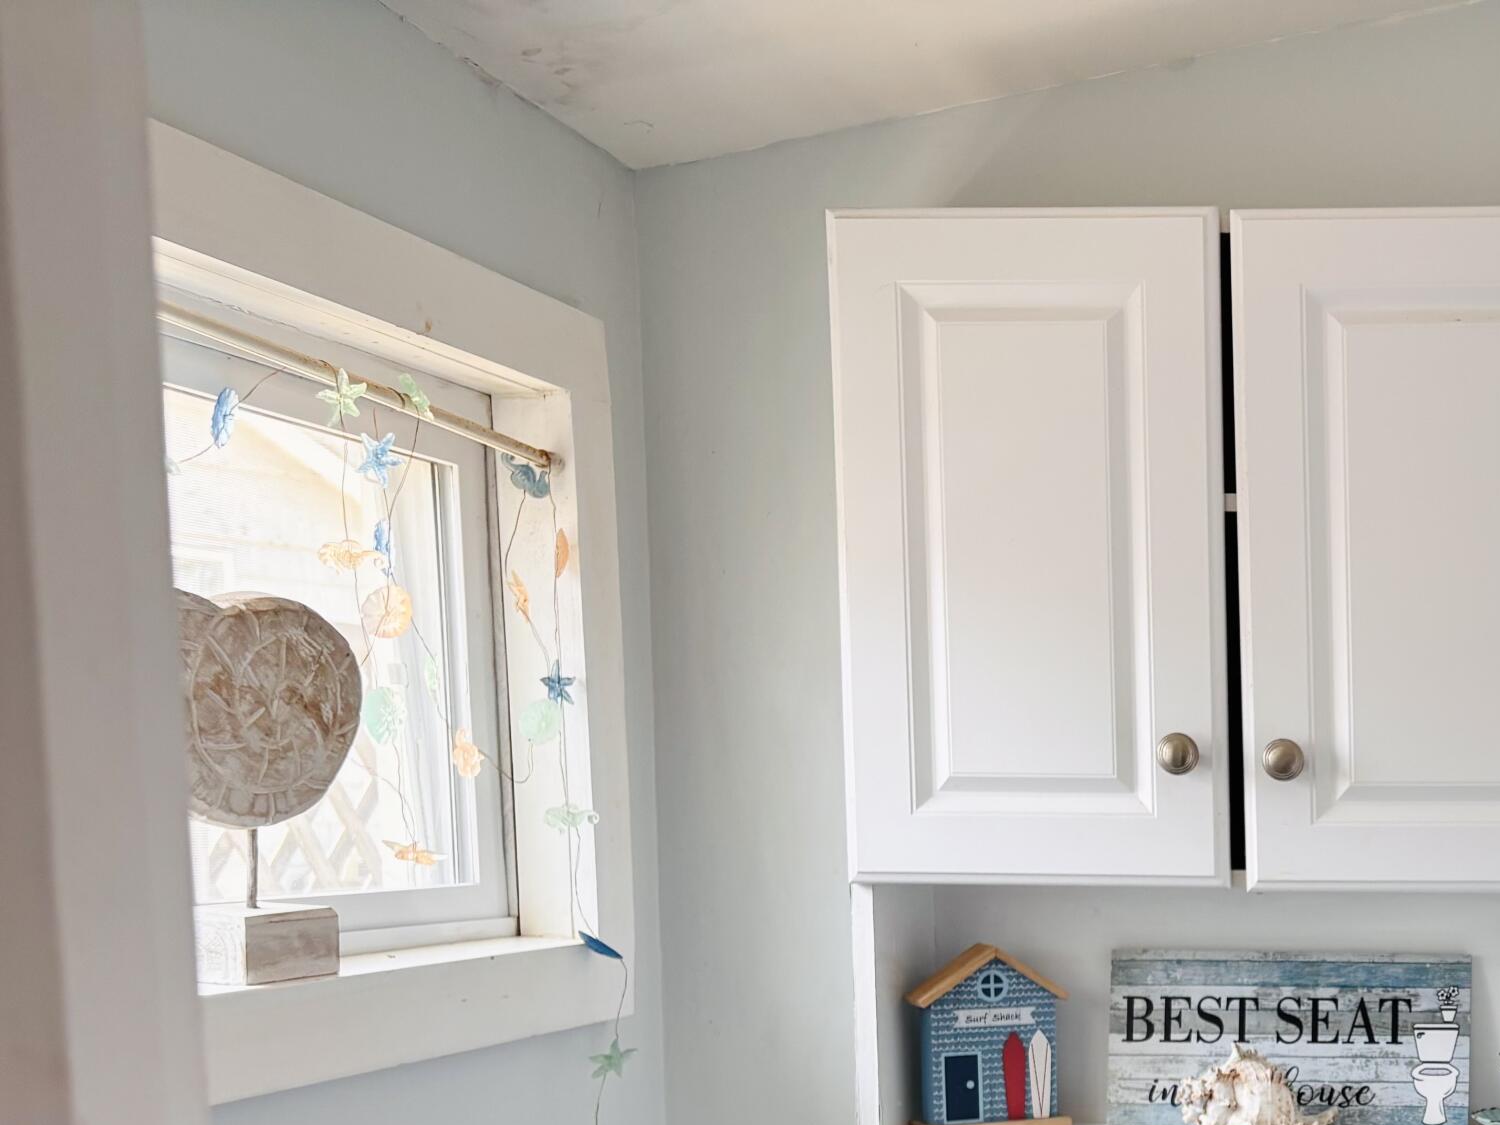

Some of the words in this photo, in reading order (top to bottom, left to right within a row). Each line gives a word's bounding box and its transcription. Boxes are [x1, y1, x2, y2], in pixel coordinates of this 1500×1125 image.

[964, 1012, 988, 1025] Surf
[992, 1011, 1021, 1023] Shack
[1122, 995, 1259, 1044] BEST
[1275, 996, 1413, 1045] SEAT
[1148, 1078, 1182, 1108] in
